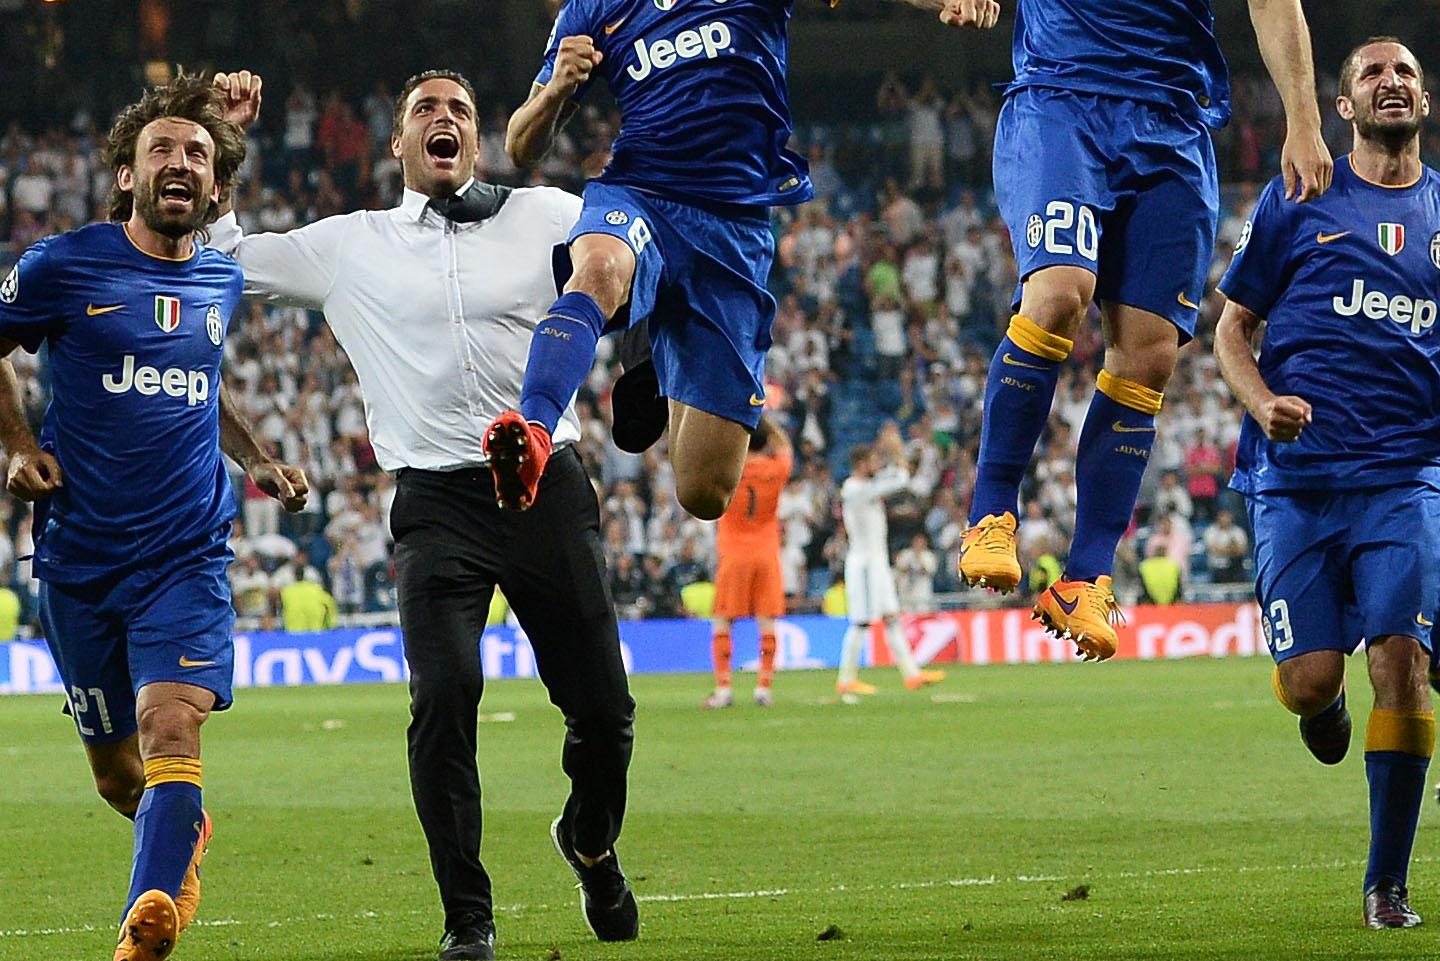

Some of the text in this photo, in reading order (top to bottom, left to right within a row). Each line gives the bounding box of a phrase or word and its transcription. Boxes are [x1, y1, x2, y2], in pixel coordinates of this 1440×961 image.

[626, 21, 732, 82] Jeep
[627, 216, 652, 255] 8
[1045, 201, 1099, 261] 20
[1332, 279, 1438, 334] Jeep
[102, 355, 209, 407] Jeep
[1270, 598, 1294, 652] 3
[71, 684, 114, 736] 21
